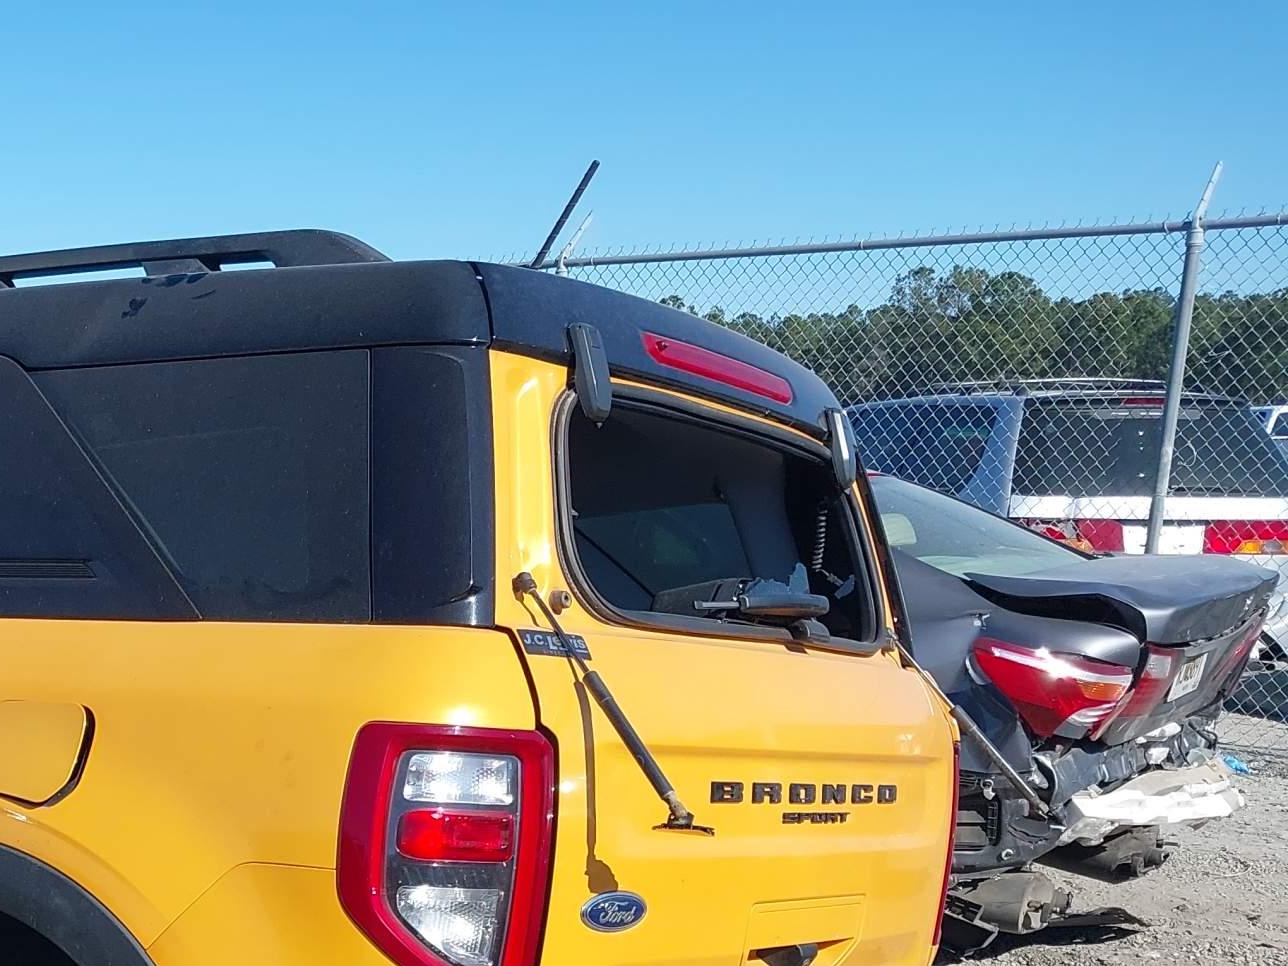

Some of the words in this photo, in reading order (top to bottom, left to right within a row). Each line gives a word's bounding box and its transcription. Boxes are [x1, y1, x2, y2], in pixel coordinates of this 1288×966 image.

[710, 781, 897, 804] BRONCO
[782, 811, 850, 824] SPORT
[593, 901, 637, 924] Ford
